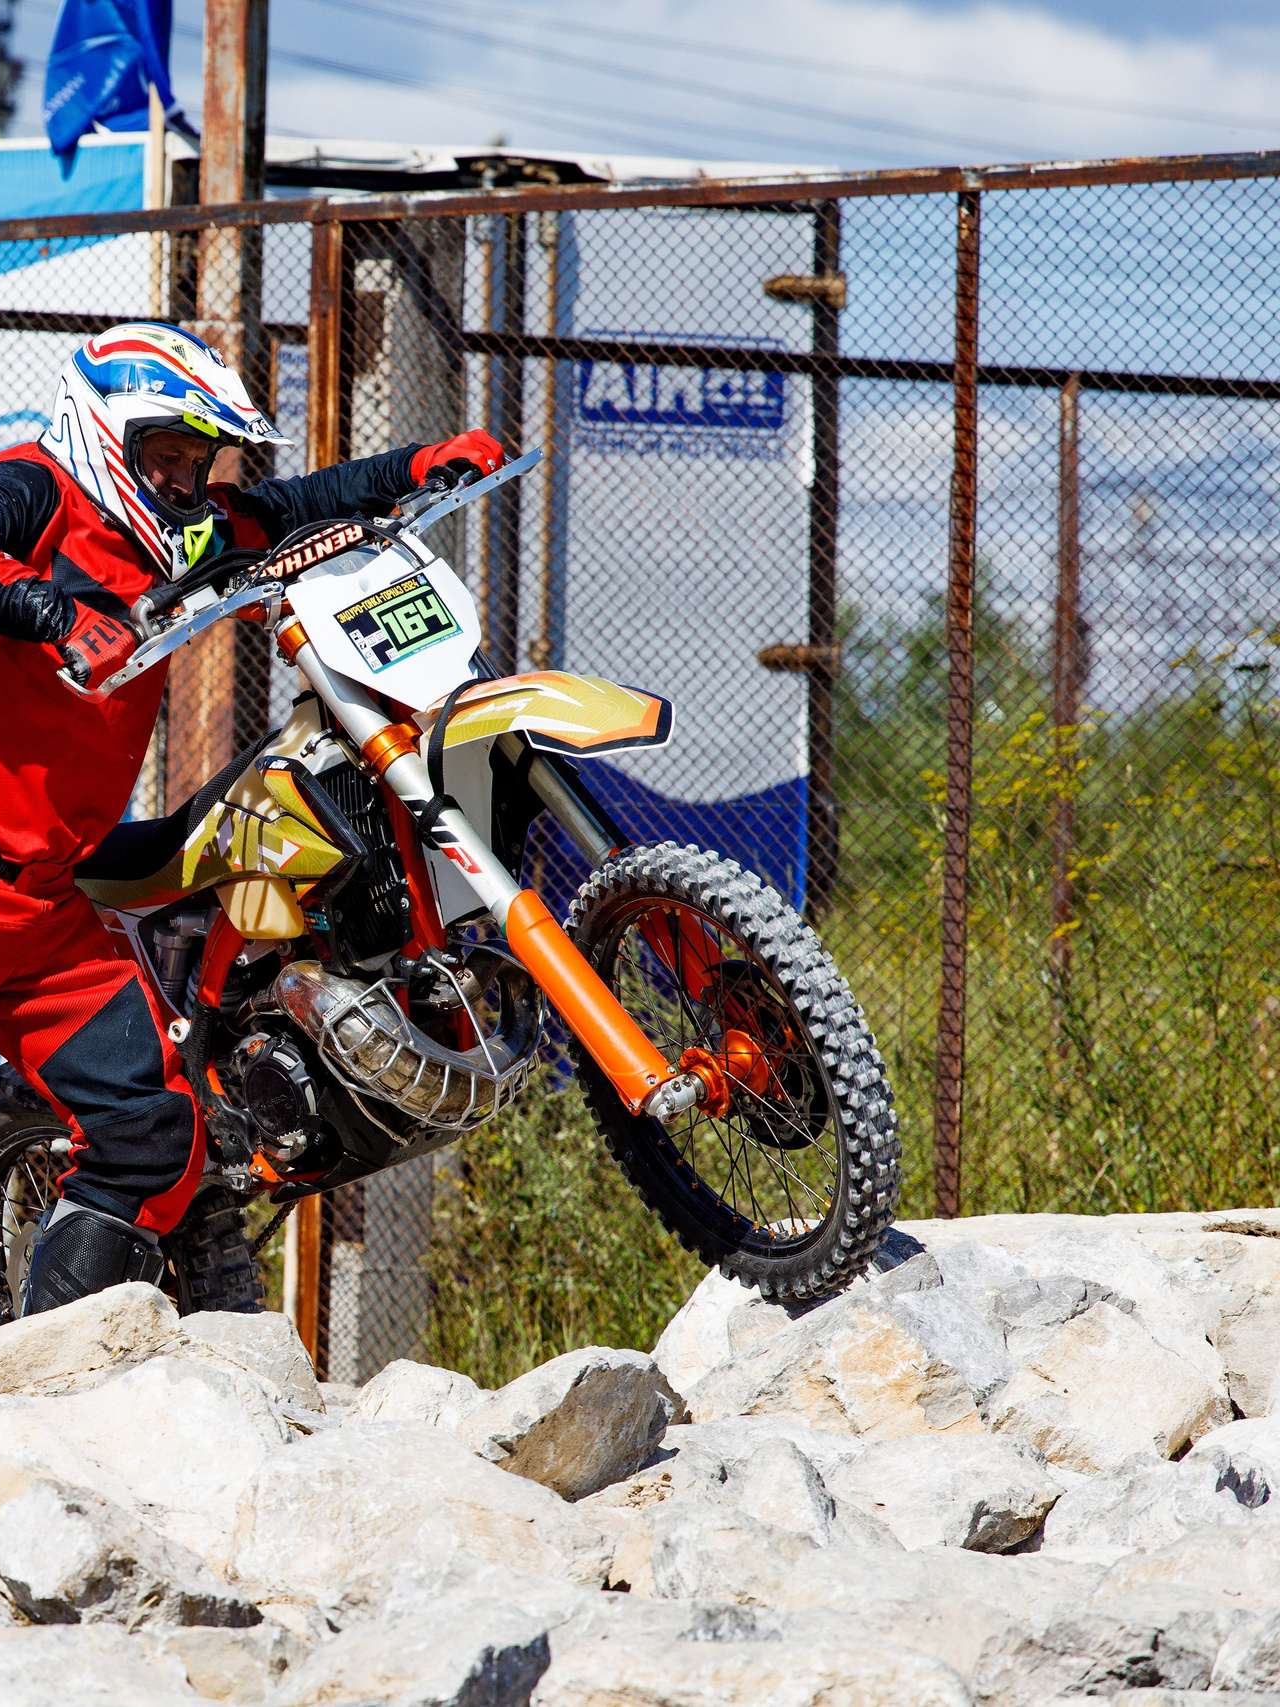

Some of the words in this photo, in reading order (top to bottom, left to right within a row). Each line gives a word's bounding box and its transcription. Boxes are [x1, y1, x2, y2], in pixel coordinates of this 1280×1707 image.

[178, 400, 208, 417] Airoh
[401, 578, 420, 593] 2024
[380, 593, 450, 645] 164
[79, 616, 124, 655] FLY
[269, 759, 290, 770] KTM
